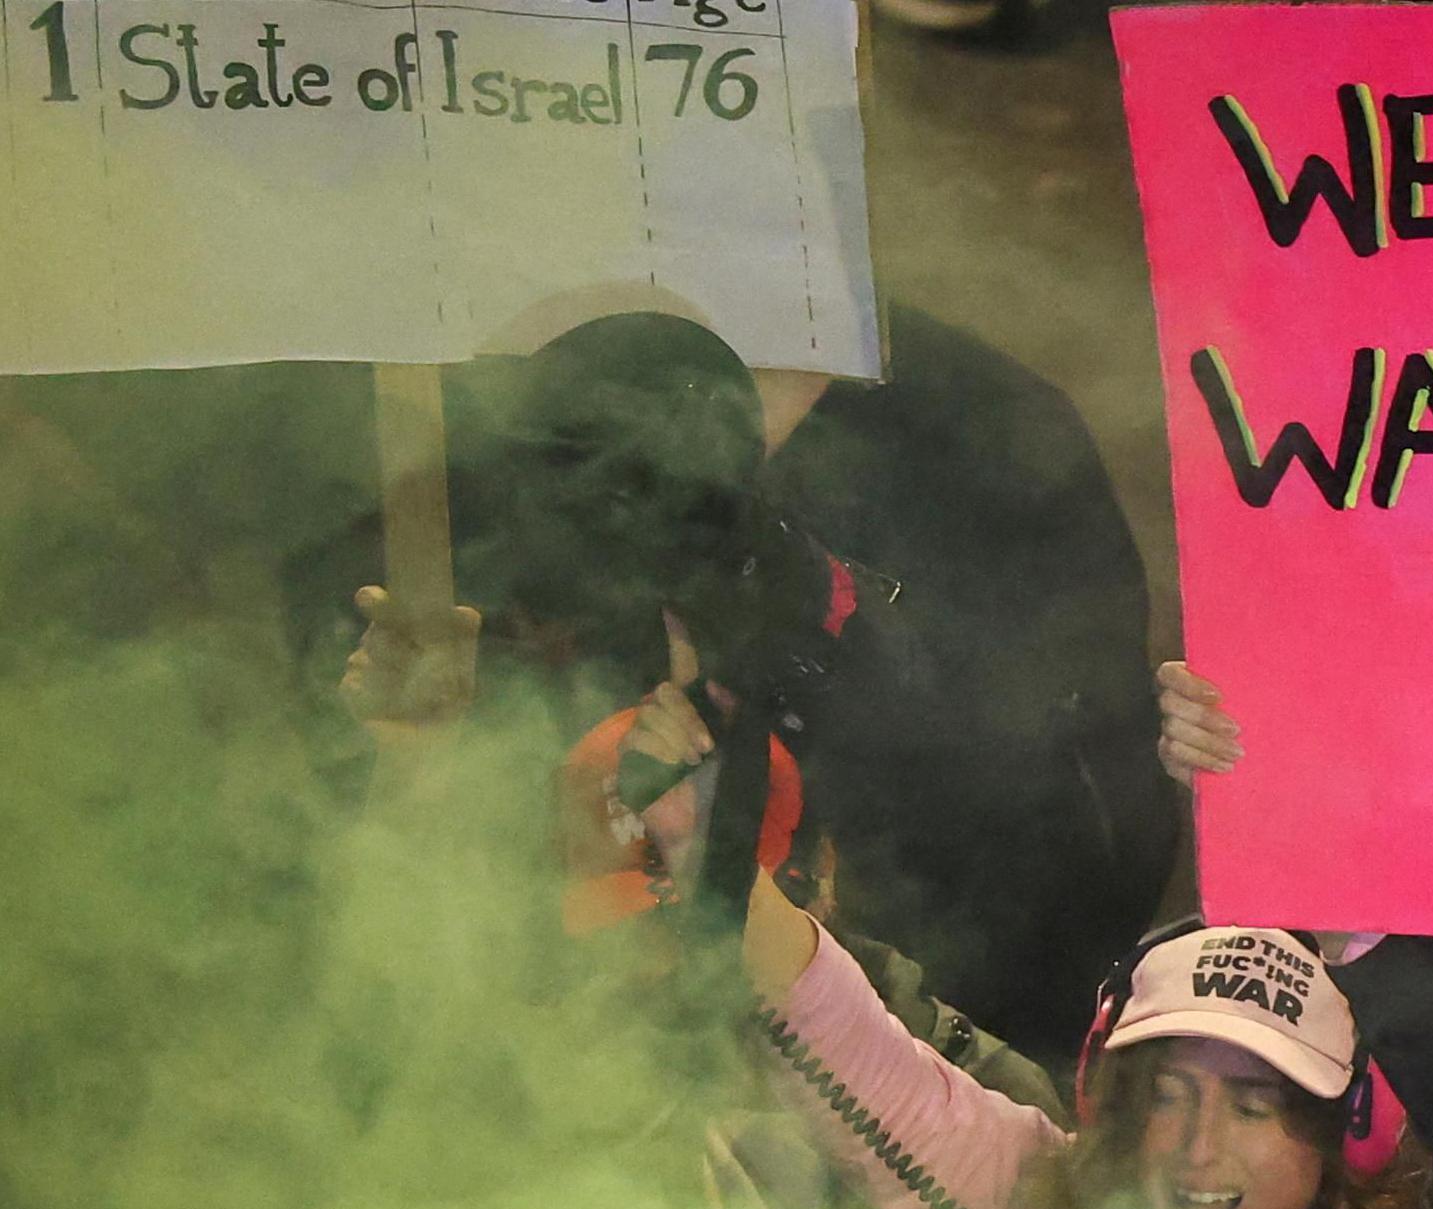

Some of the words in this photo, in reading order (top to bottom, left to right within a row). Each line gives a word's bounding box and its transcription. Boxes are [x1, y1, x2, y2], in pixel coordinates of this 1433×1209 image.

[29, 1, 79, 101] 1
[118, 23, 333, 109] State
[358, 32, 418, 111] of
[435, 30, 623, 125] Israel
[645, 44, 759, 120] 76
[1201, 936, 1255, 951] END
[1261, 939, 1314, 979] THIS
[1192, 972, 1304, 1027] WAR
